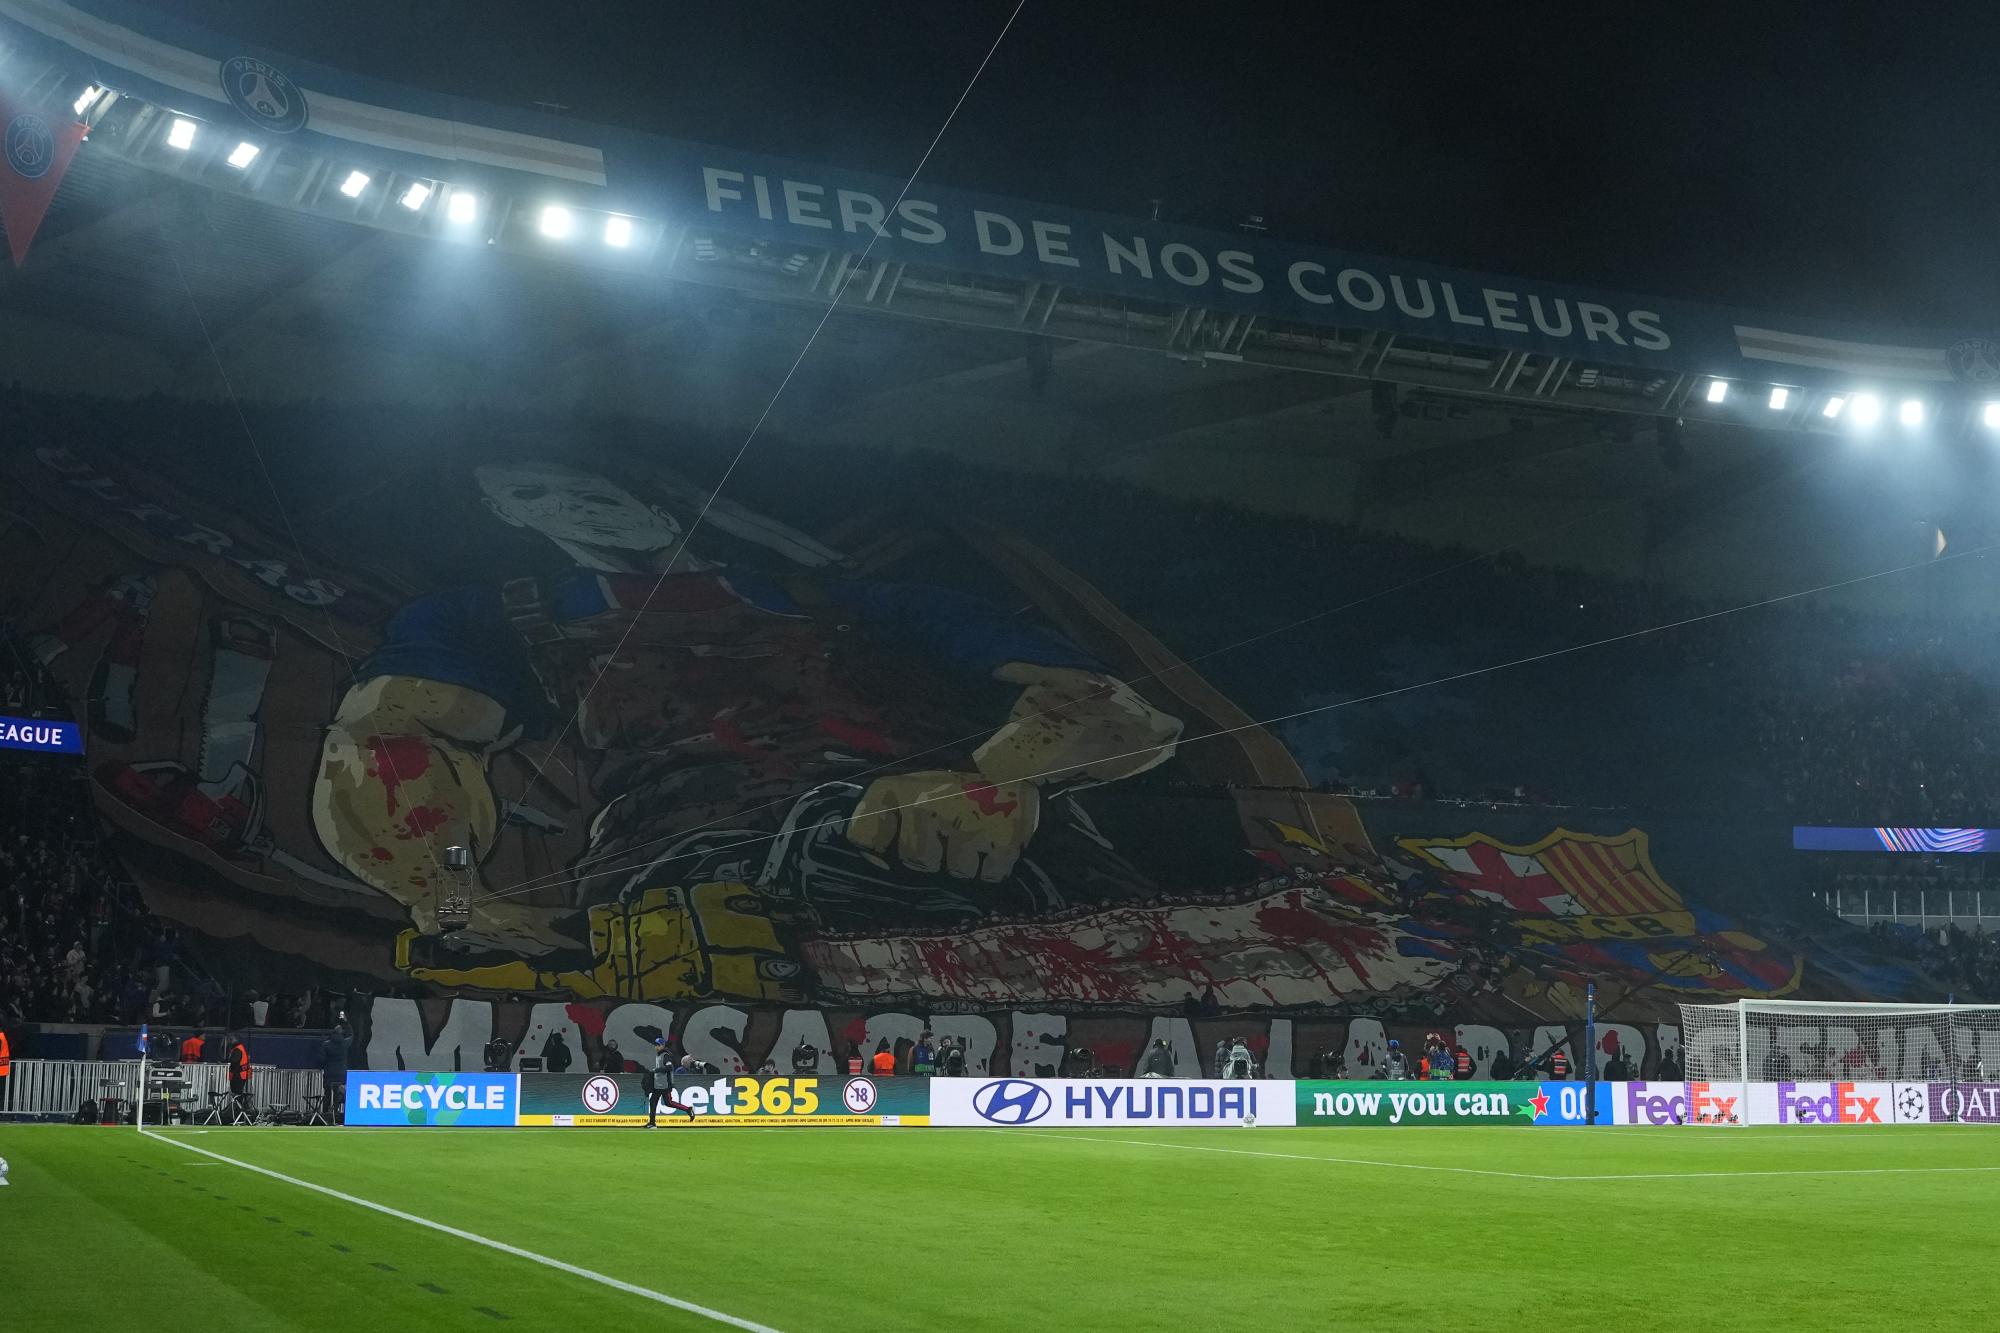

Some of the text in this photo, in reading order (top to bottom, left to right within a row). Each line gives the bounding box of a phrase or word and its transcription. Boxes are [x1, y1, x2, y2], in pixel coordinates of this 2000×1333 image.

[232, 60, 285, 87] PARIS
[703, 167, 1671, 352] FIERS DE NOS COULEURS
[360, 1084, 505, 1110] RECYCLE
[1065, 1086, 1257, 1119] HYUNDAI
[1313, 1092, 1510, 1123] now you can
[1627, 1081, 1739, 1125] FedEx
[1777, 1082, 1882, 1124] FedEx
